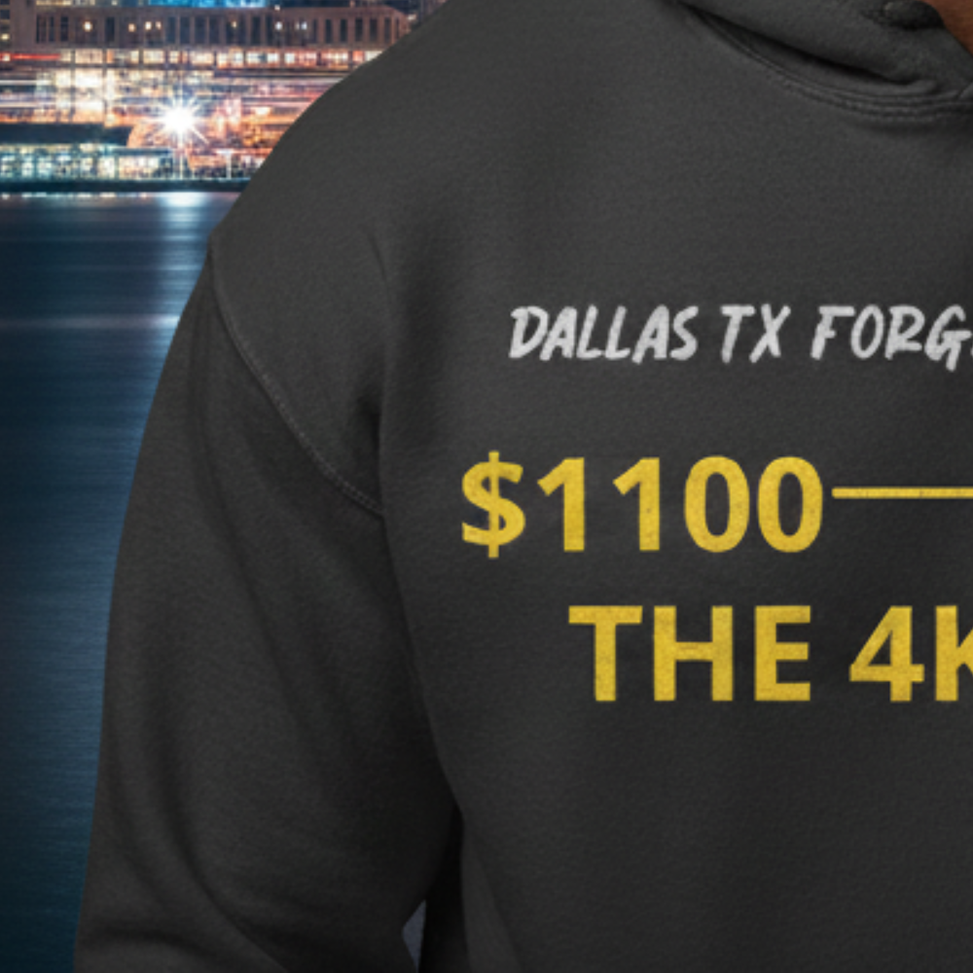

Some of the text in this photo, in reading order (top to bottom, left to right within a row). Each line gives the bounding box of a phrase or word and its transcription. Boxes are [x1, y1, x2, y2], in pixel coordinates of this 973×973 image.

[508, 303, 700, 365] DALLAS
[719, 303, 792, 364] TX
[461, 450, 824, 559] $1100
[568, 604, 812, 703] THE
